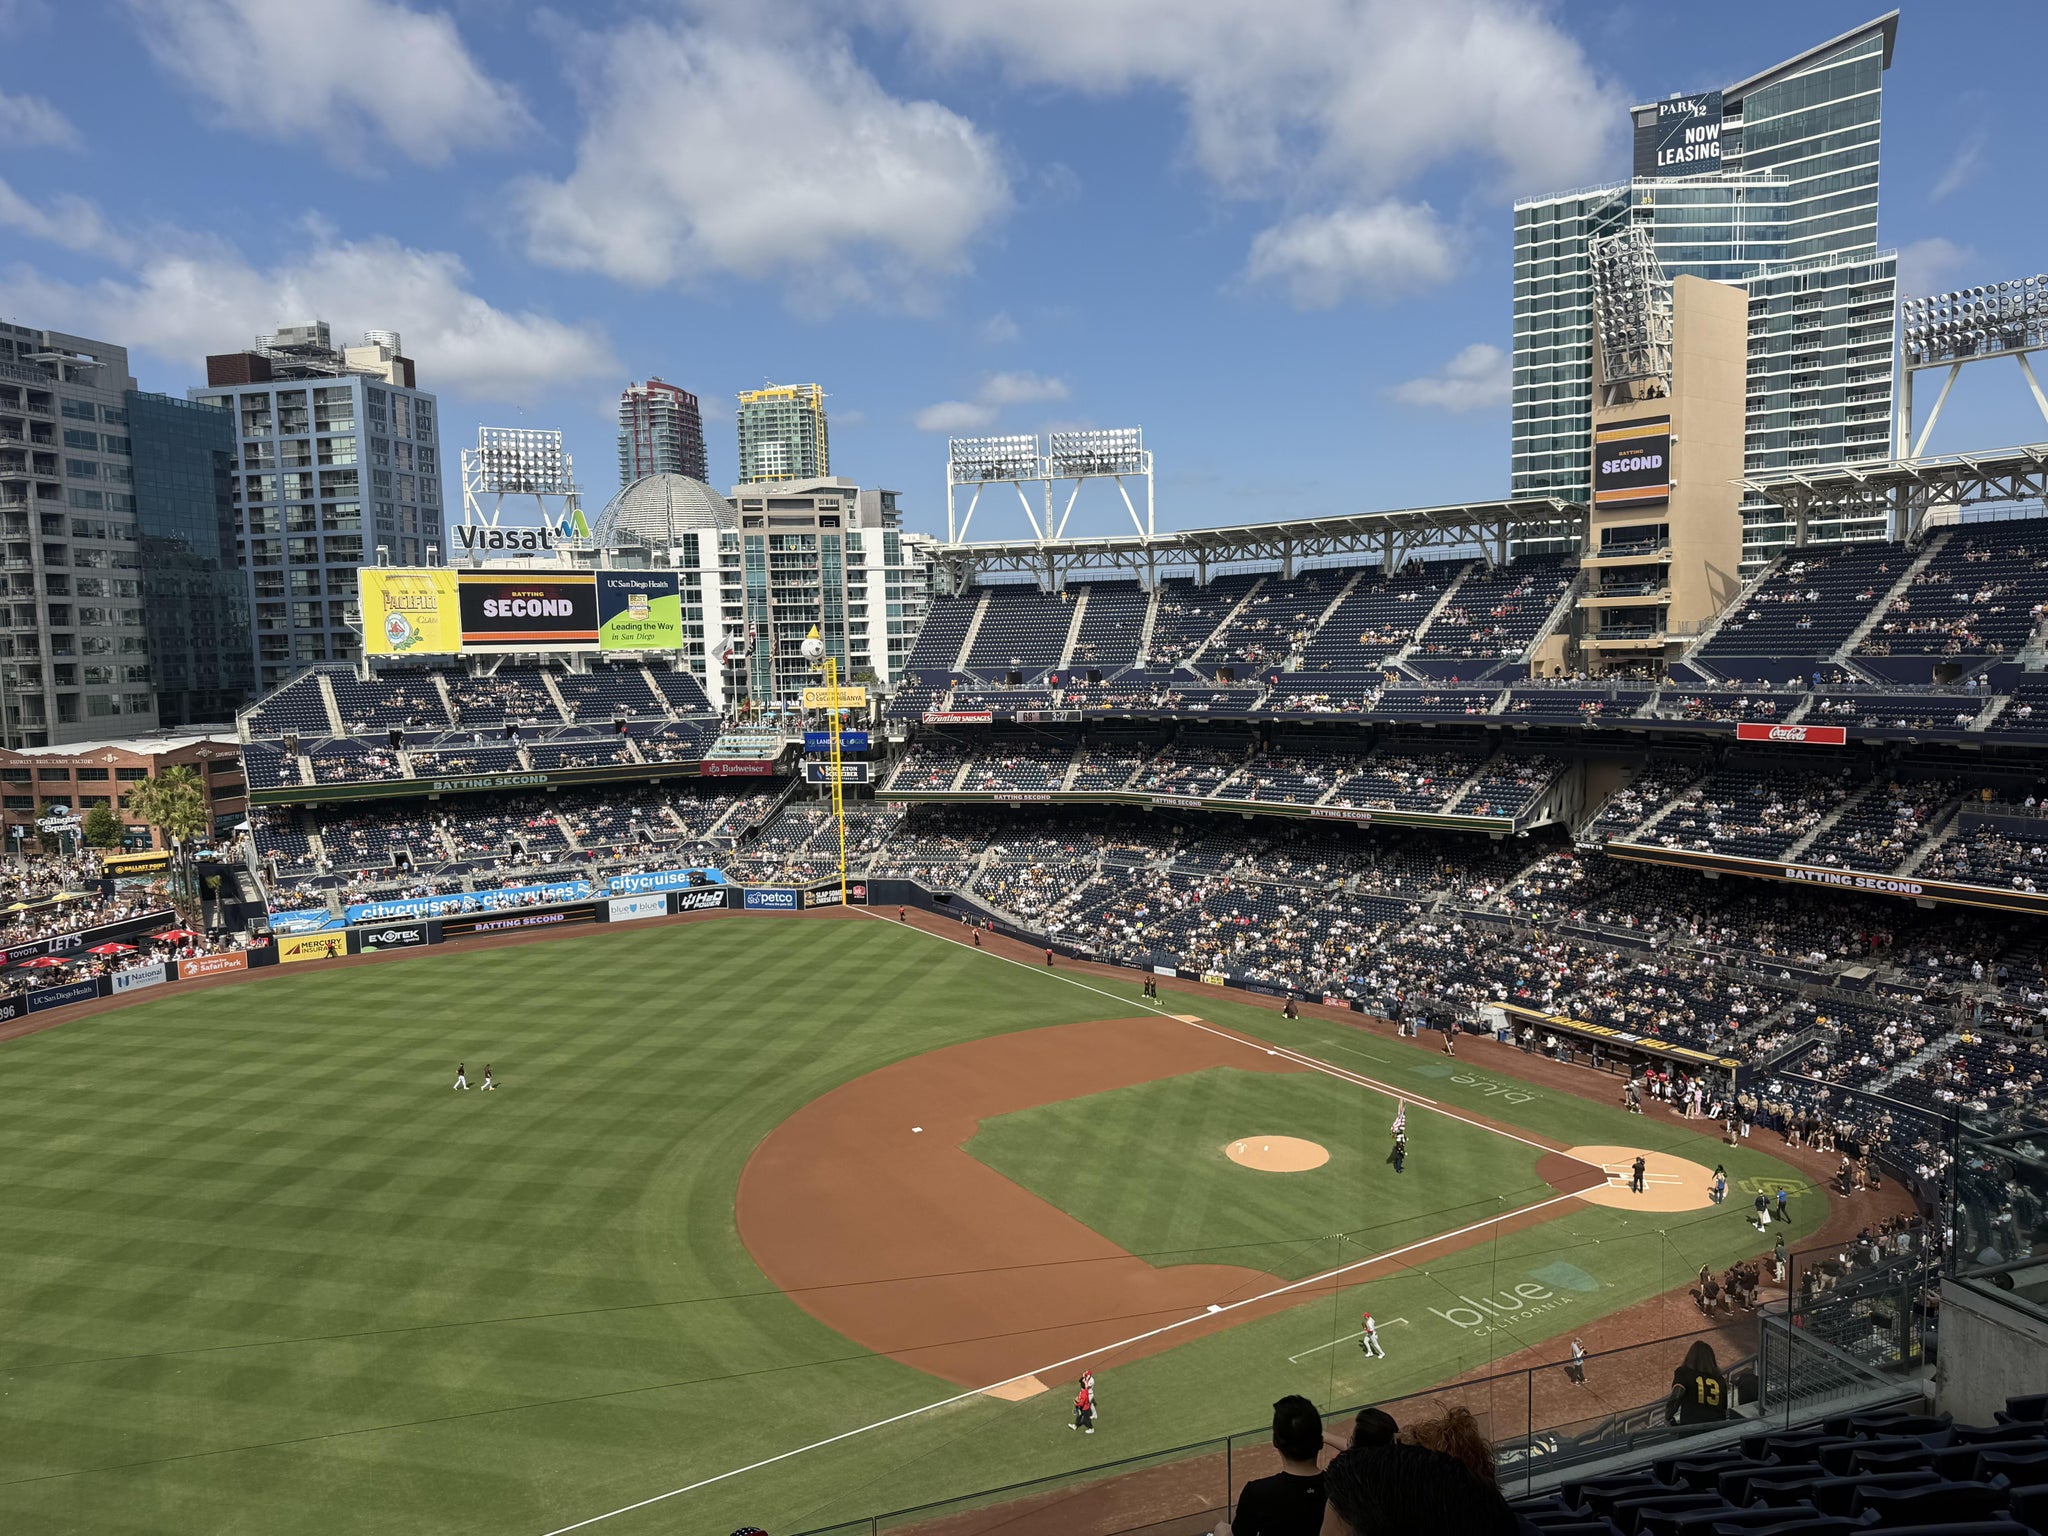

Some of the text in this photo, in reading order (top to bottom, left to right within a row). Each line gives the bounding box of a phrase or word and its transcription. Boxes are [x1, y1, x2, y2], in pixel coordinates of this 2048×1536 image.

[1659, 99, 1696, 116] PARK
[1685, 123, 1720, 145] NOW
[1657, 141, 1720, 167] LEASING
[1618, 448, 1644, 456] BATTING
[1601, 454, 1663, 474] SECOND
[456, 525, 553, 550] Viasat
[630, 580, 648, 589] Diego
[648, 580, 669, 588] Health
[483, 599, 573, 617] SECOND
[611, 623, 643, 631] Leading
[657, 623, 674, 631] Way
[636, 633, 655, 641] Diego
[924, 713, 961, 722] Tarantino
[722, 764, 764, 772] Budweiser
[433, 775, 548, 790] BATTING SECOND
[1151, 797, 1177, 805] BATTING
[1310, 809, 1372, 819] BATTING SECOND
[37, 815, 82, 827] Gallagher
[44, 824, 79, 834] Square
[149, 862, 167, 870] POINT
[1785, 868, 1923, 895] BATTING SECOND
[761, 891, 792, 904] petco
[611, 906, 630, 914] blue
[639, 901, 658, 910] blue
[693, 900, 721, 909] POWER
[475, 914, 564, 931] BATTING SECOND
[369, 929, 418, 943] EVOTEK
[9, 933, 82, 959] TOYOTA LET'S
[301, 938, 342, 948] MERCURY
[200, 959, 241, 972] Safari Park
[131, 968, 162, 981] National
[33, 986, 92, 1005] UC San Diego Health
[1449, 1074, 1535, 1105] blue
[1426, 1283, 1554, 1329] blue
[1473, 1296, 1573, 1337] CALIFORNIA
[1695, 1375, 1720, 1406] 13
